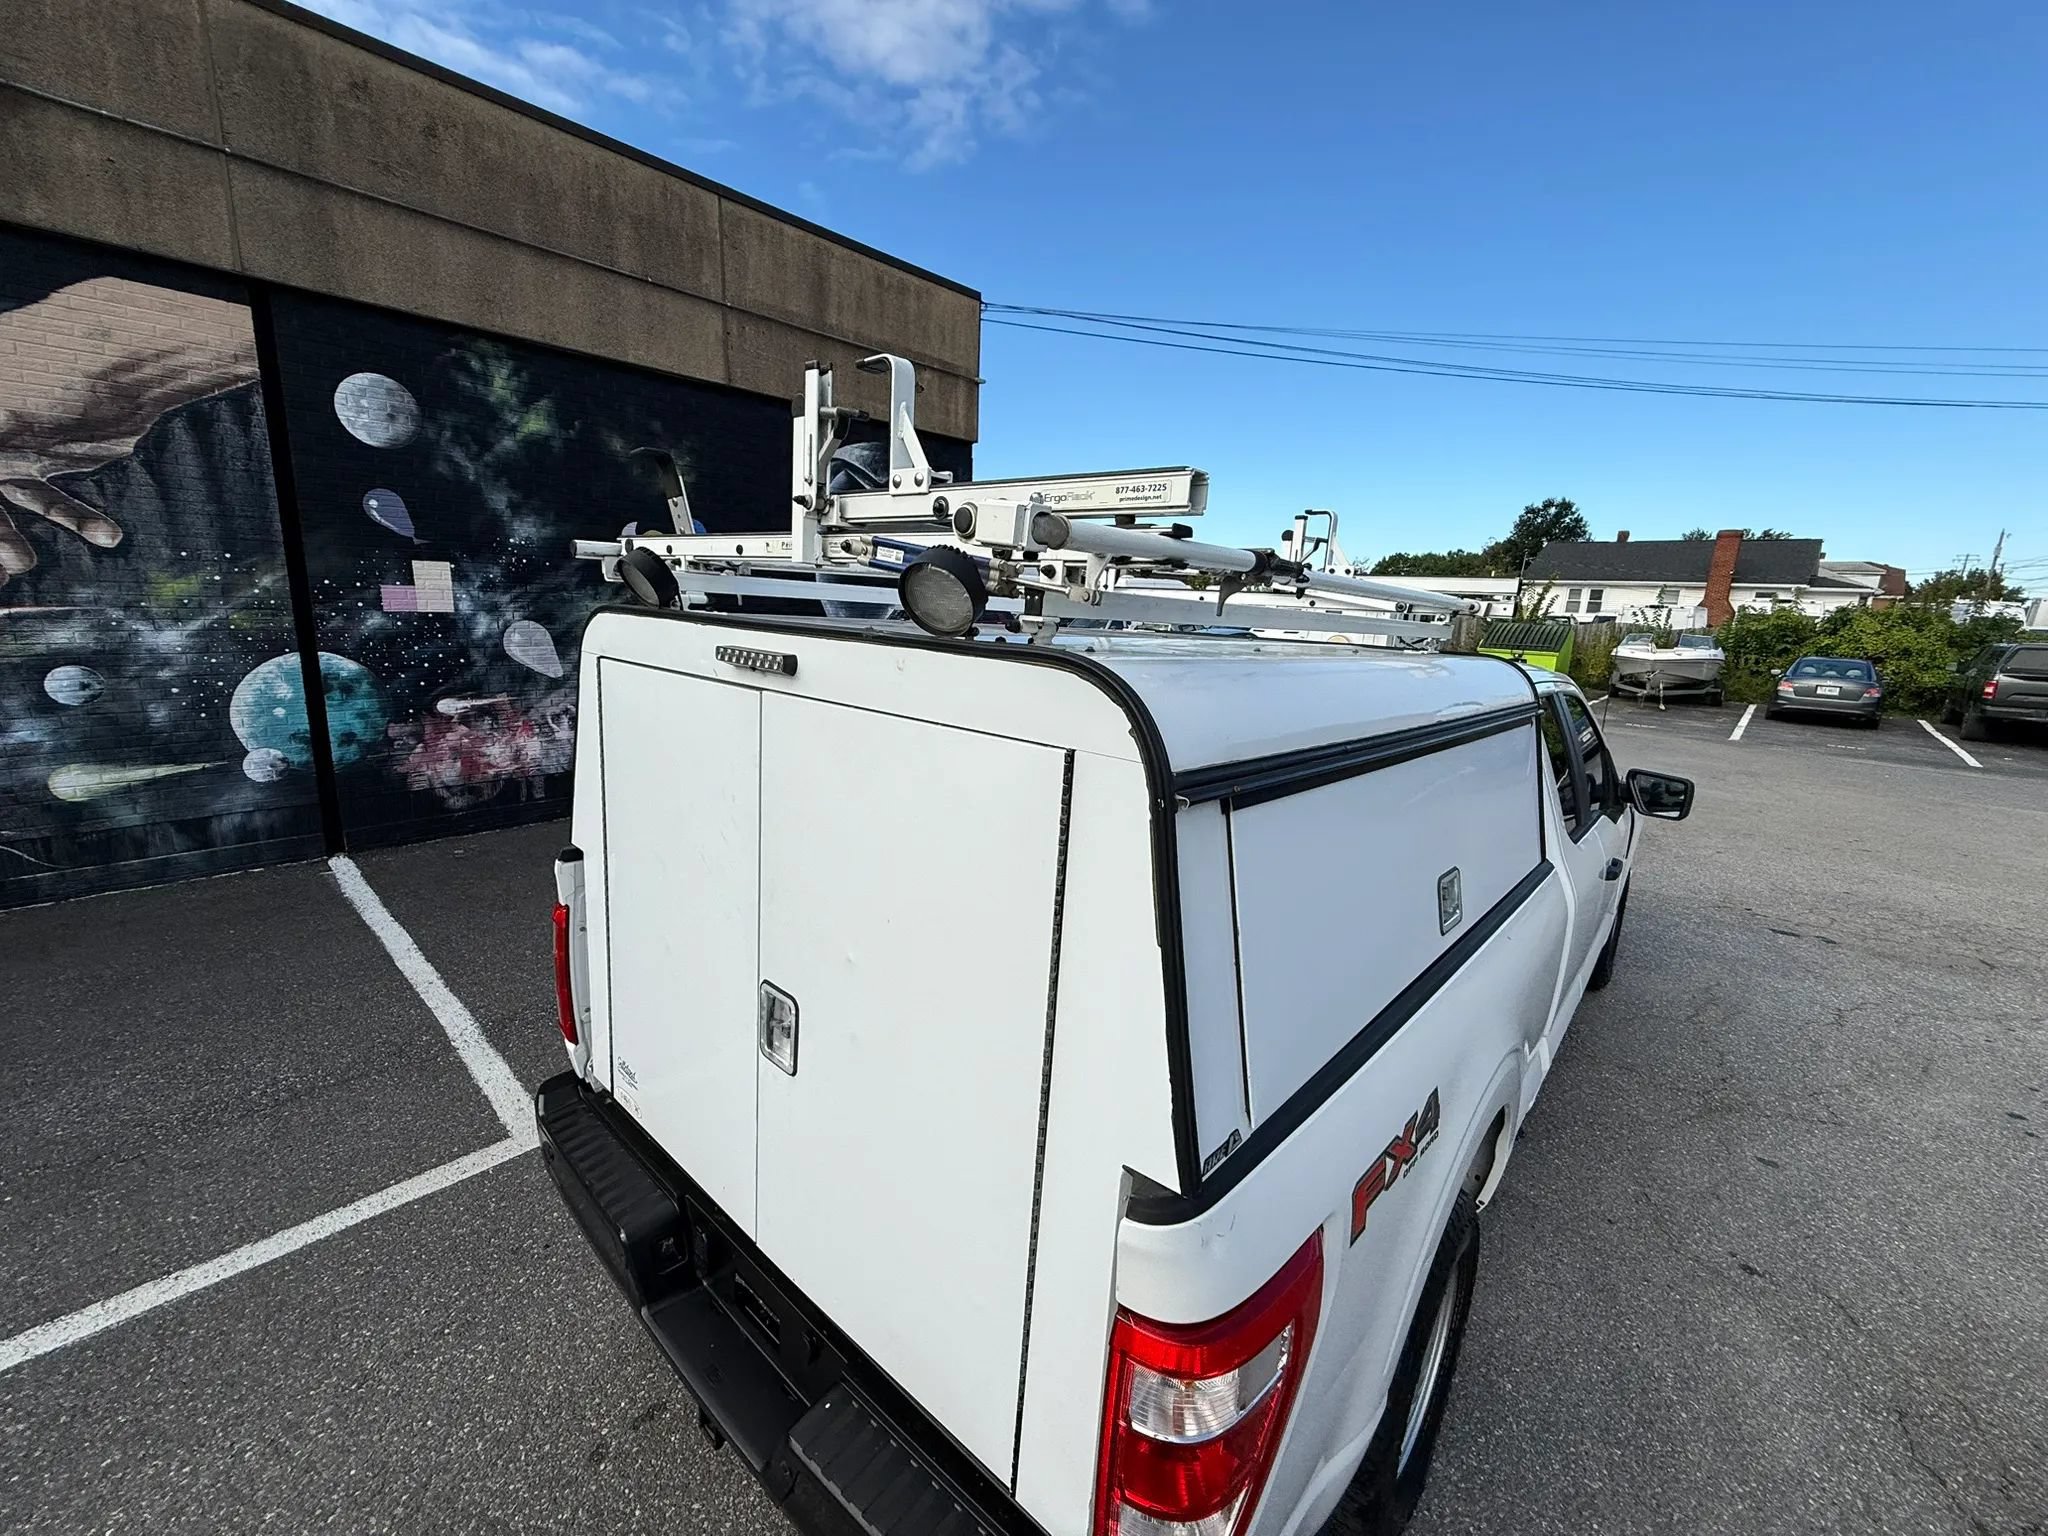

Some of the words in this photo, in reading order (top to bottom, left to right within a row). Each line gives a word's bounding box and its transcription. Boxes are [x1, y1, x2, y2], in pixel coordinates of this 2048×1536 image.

[1115, 483, 1167, 494] 877-463-7225
[1119, 494, 1162, 503] primedesign.net
[1349, 1085, 1440, 1248] FX4
